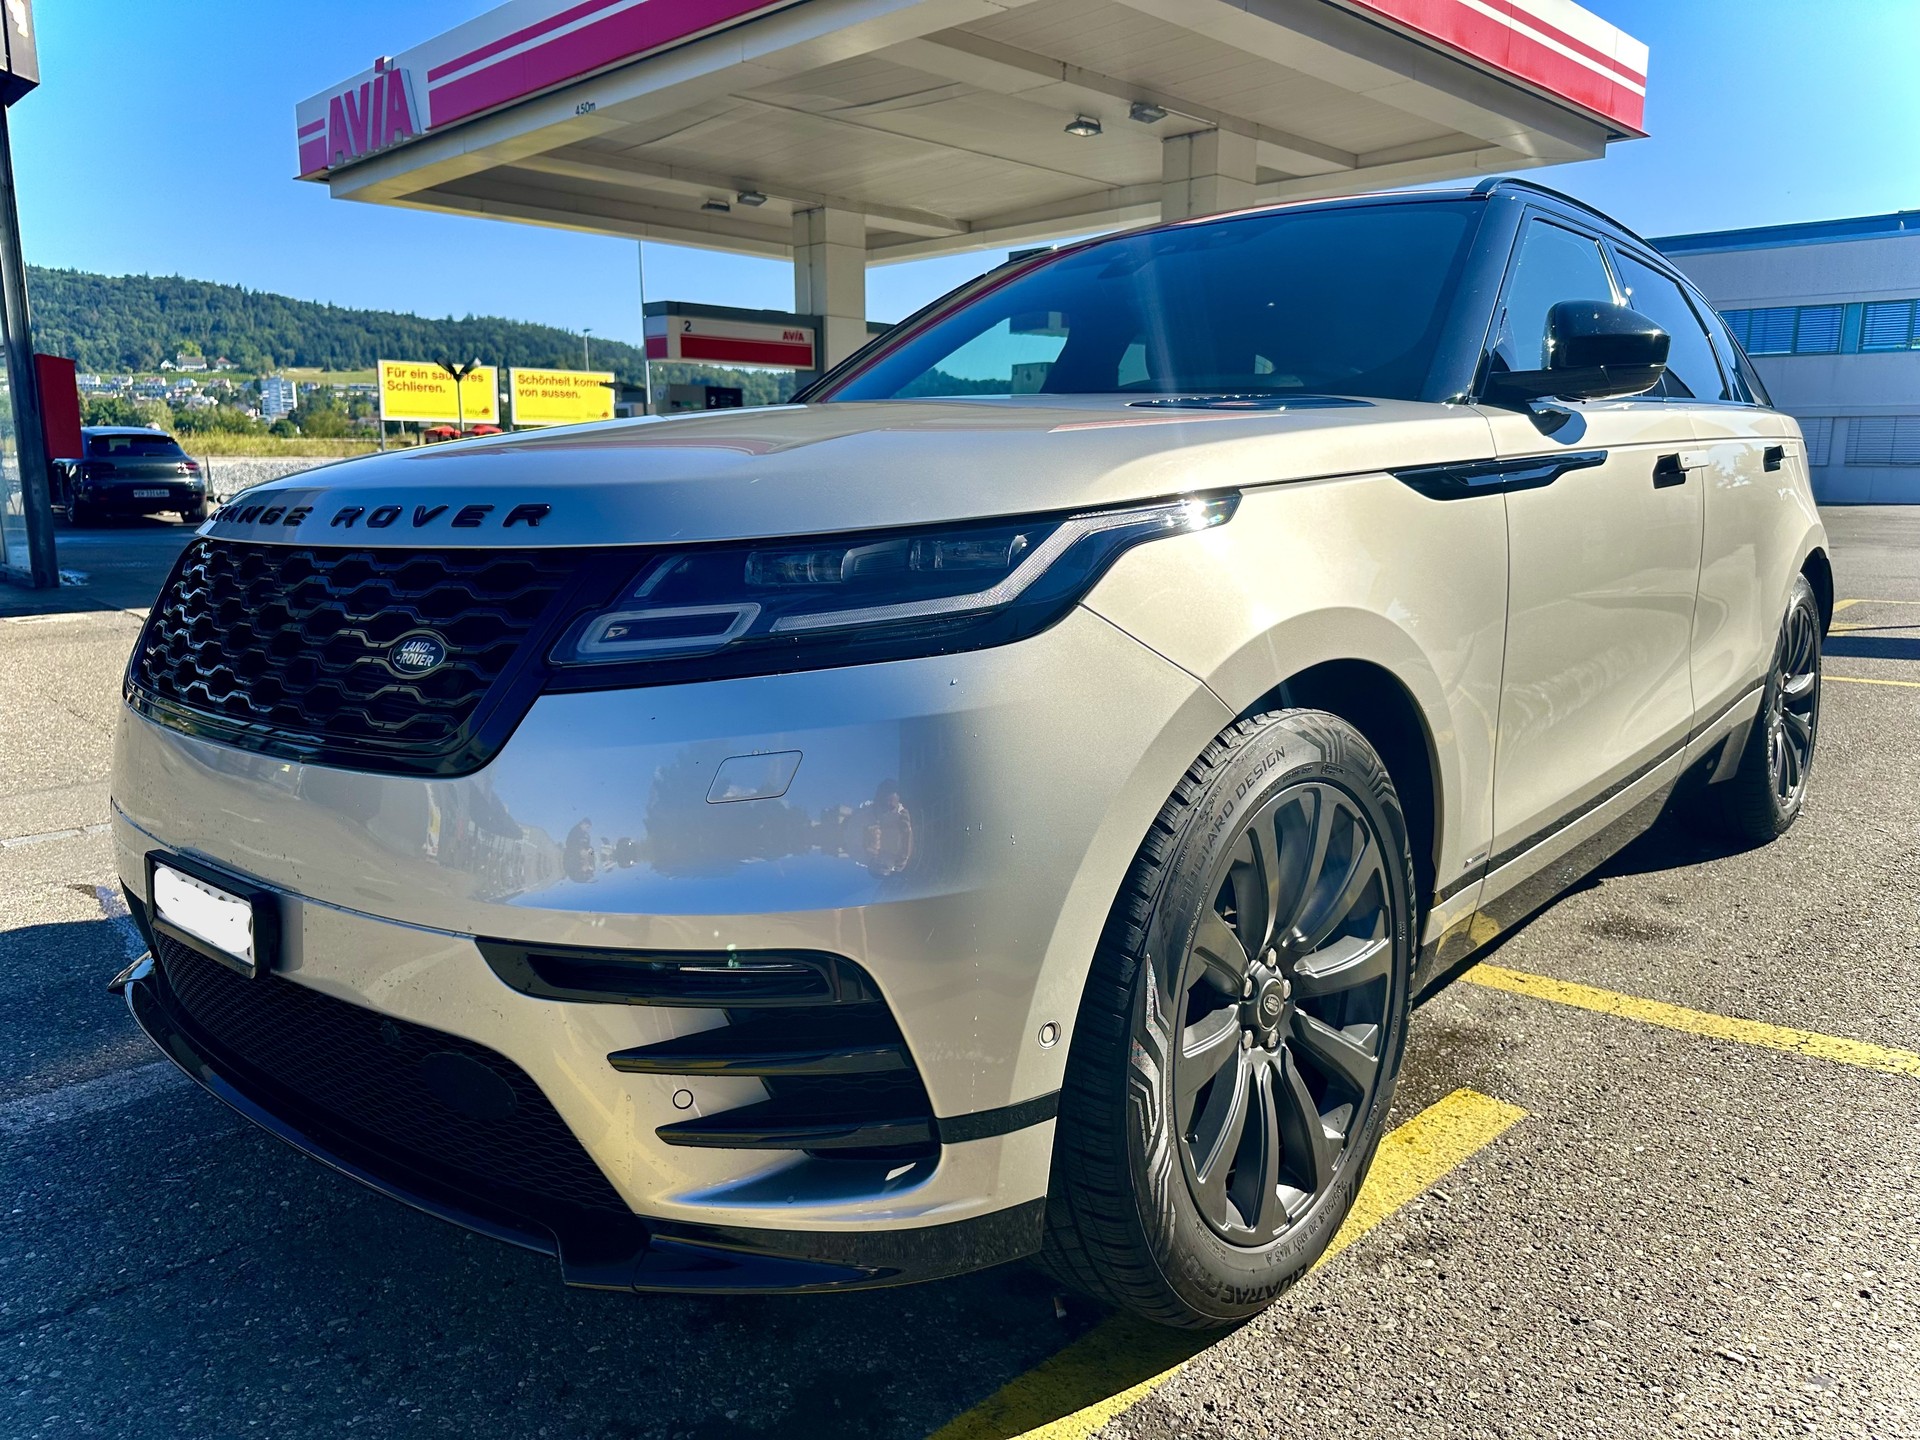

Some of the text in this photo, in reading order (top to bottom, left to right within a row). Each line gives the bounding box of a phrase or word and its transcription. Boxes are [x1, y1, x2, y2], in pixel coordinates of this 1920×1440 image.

[684, 320, 692, 332] 2
[782, 329, 805, 342] AVIA
[386, 366, 406, 378] Für
[410, 370, 428, 379] ein
[387, 380, 446, 393] Schlieren.
[518, 374, 570, 387] Schönheit
[519, 388, 581, 399] von aussen.
[330, 503, 551, 528] ROVER
[401, 641, 430, 653] LAND
[400, 652, 434, 666] ROVER
[1235, 746, 1286, 800] DESIGN
